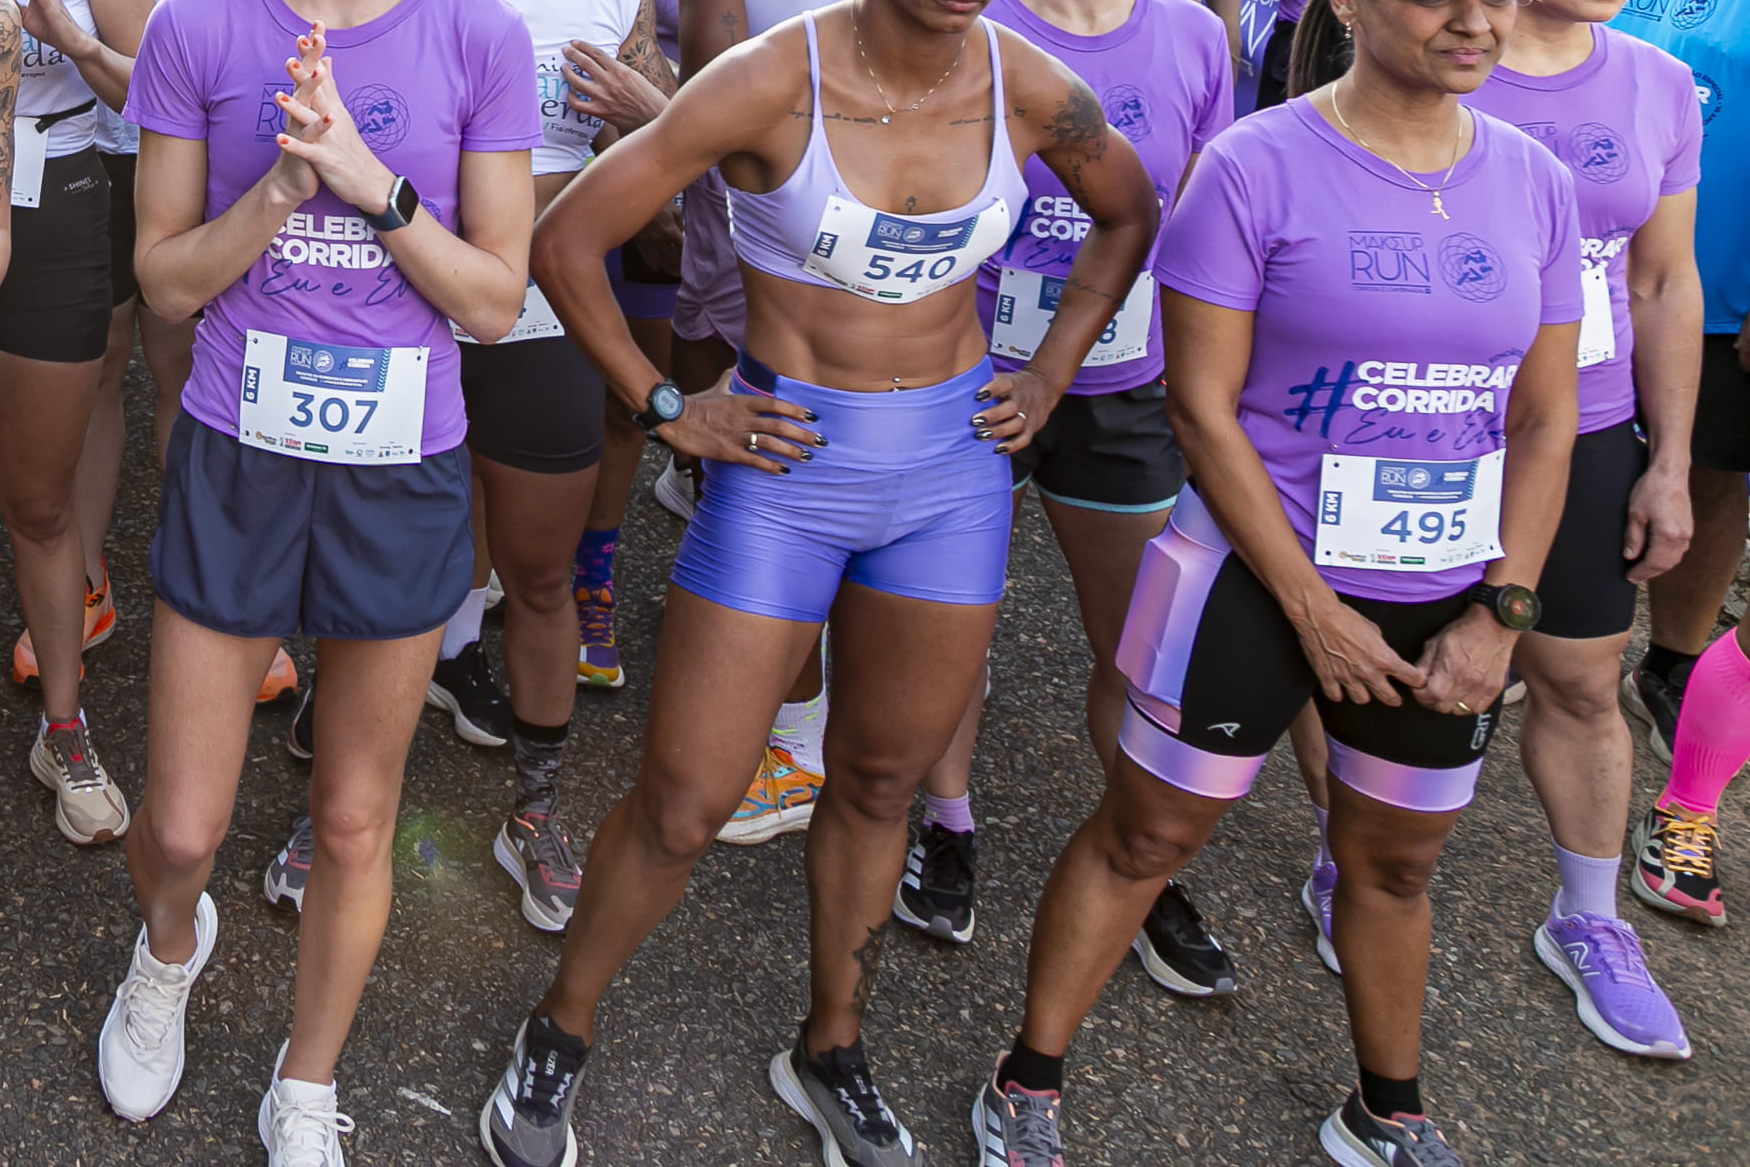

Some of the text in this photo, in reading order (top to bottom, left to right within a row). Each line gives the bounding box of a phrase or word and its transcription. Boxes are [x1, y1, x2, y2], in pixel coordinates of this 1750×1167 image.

[822, 233, 835, 250] KM
[863, 255, 957, 283] 540
[1350, 250, 1431, 283] RUN
[1001, 297, 1012, 313] KM
[290, 352, 312, 366] RUN
[247, 369, 258, 390] KM
[246, 391, 256, 401] 6
[1352, 386, 1495, 414] CORRIDA
[289, 391, 379, 434] 307
[1344, 407, 1416, 445] Eu
[1426, 428, 1447, 443] e
[1381, 472, 1407, 484] RUN
[1326, 493, 1339, 513] KM
[1325, 514, 1337, 523] 6
[1380, 508, 1467, 544] 495
